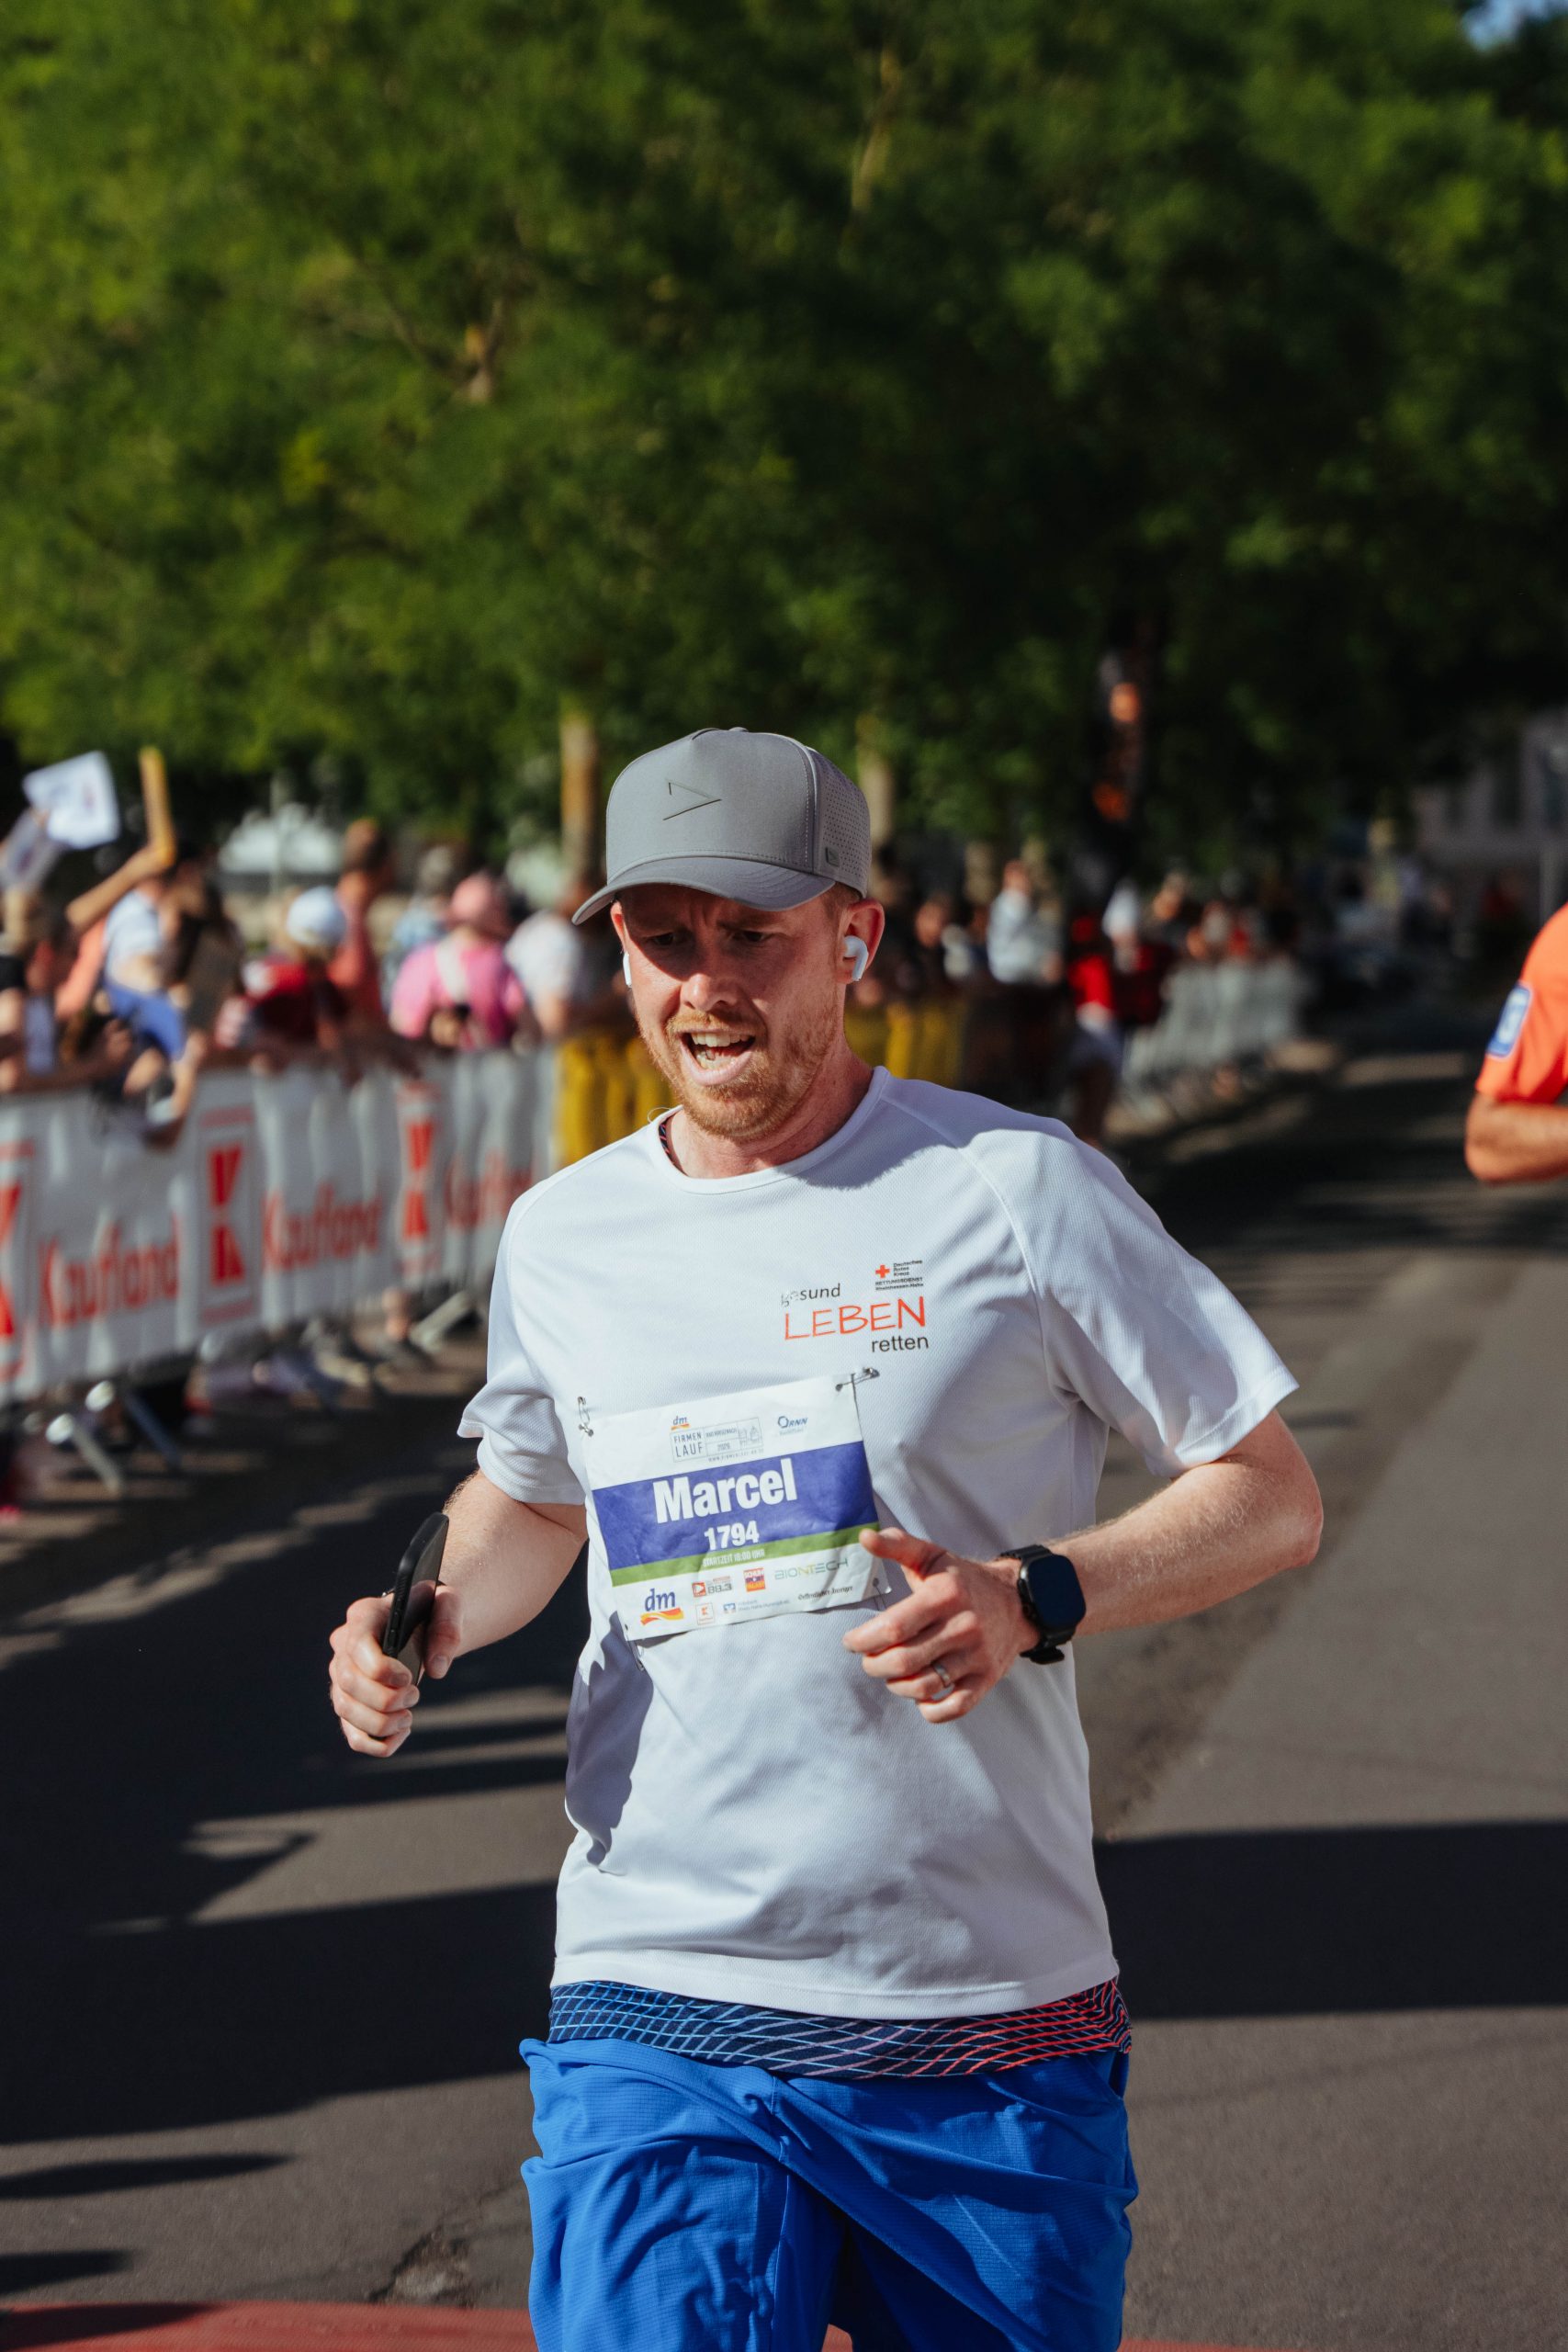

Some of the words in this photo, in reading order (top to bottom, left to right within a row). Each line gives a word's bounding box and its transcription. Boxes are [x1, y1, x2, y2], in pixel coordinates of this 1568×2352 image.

[784, 1295, 925, 1340] LEBEN
[872, 1336, 929, 1352] retten
[672, 1416, 688, 1426] dm
[674, 1432, 702, 1442] FIRMEN
[675, 1442, 703, 1457] LAUF
[653, 1458, 797, 1523] Marcel
[705, 1521, 760, 1551] 1794
[703, 1554, 733, 1567] STARTZEIT
[774, 1558, 848, 1580] BIONTECH
[645, 1588, 676, 1612] dm
